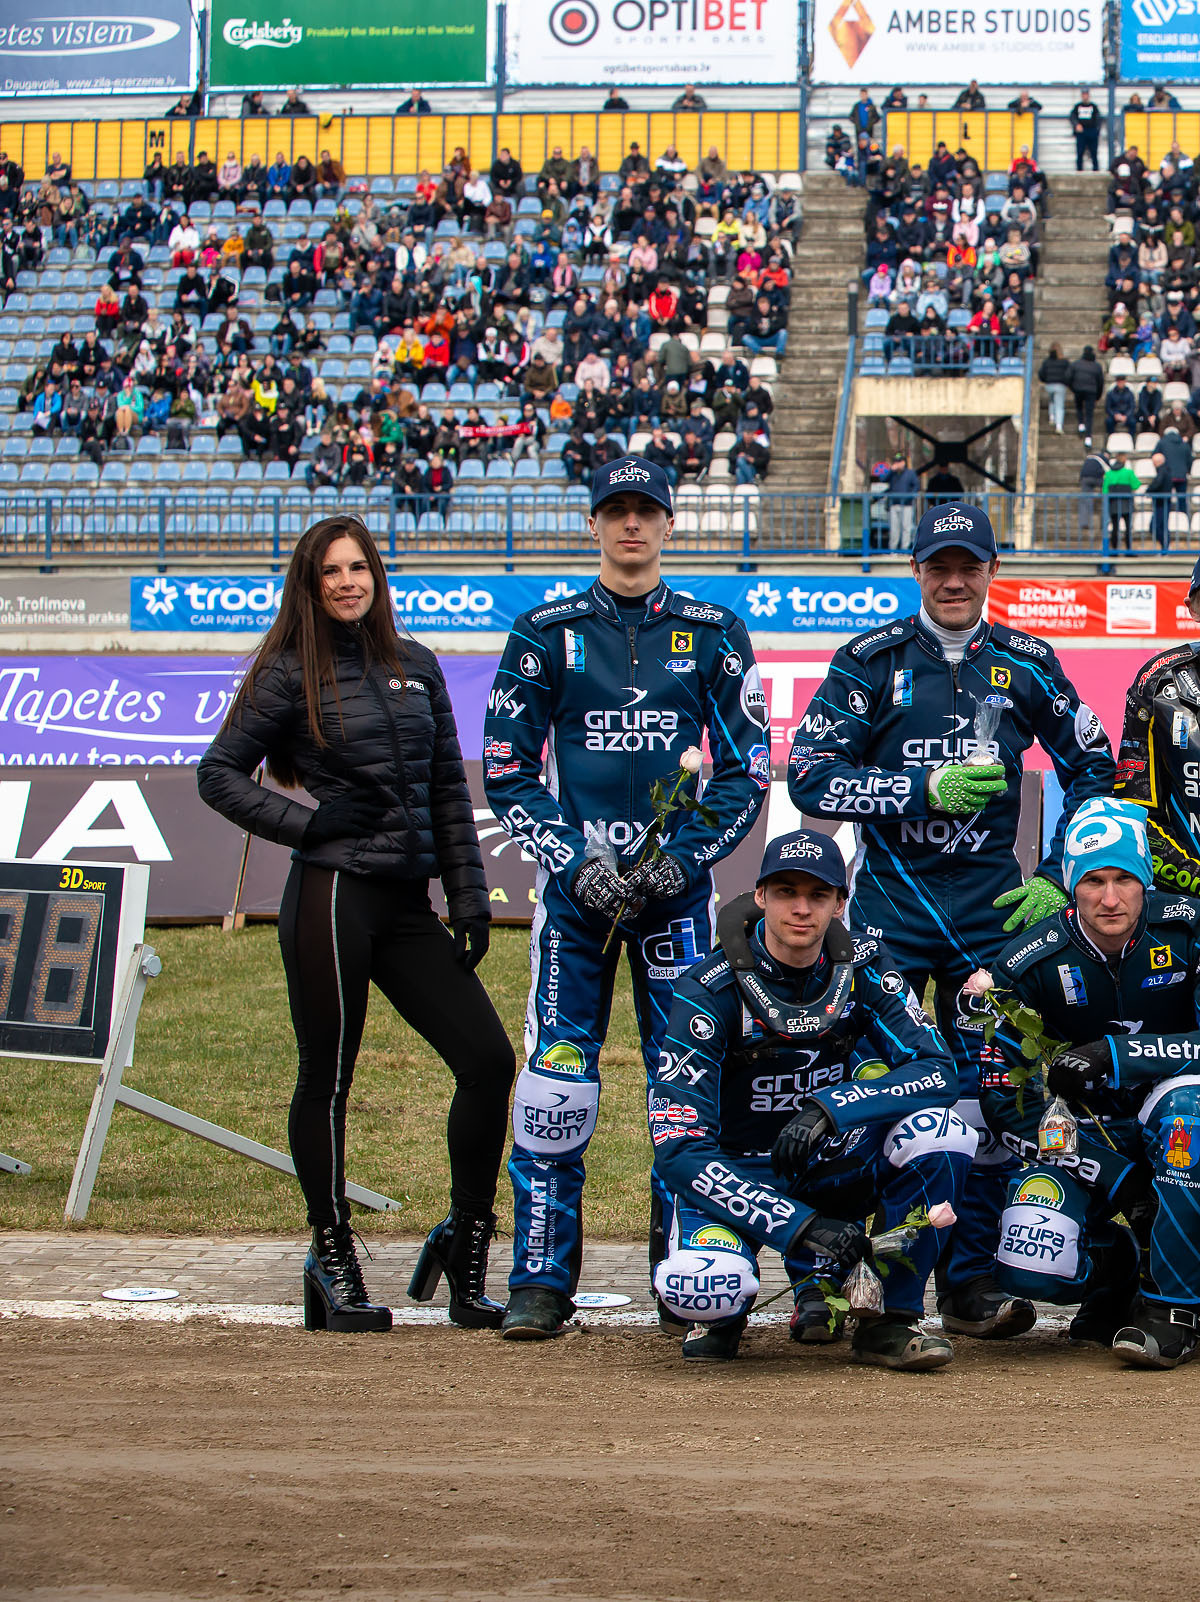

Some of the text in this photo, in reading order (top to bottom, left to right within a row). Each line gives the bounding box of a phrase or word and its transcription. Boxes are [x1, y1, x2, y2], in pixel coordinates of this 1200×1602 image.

[613, 0, 768, 31] OPTIBET
[887, 9, 1091, 33] AMBER STUDIOS
[222, 18, 303, 49] Carlsberg
[306, 27, 349, 38] Probably
[445, 24, 475, 35] World
[150, 130, 165, 147] M
[390, 585, 493, 613] trodo
[787, 587, 898, 614] trodo
[1110, 588, 1152, 601] PUFAS
[191, 615, 214, 626] CAR
[216, 615, 253, 627] PARTS
[414, 615, 492, 626] PARTS ONLINE
[531, 603, 573, 623] CHEMART
[793, 617, 853, 627] CAR PARTS
[1007, 604, 1087, 618] REMONTAM
[851, 631, 889, 655] CHEMART
[1180, 670, 1200, 697] CHEMART
[0, 668, 166, 734] Tapetes
[59, 867, 107, 891] 3D SPORT
[1006, 937, 1044, 969] CHEMART
[543, 927, 562, 1027] Saletromag
[649, 967, 675, 978] dasta
[1147, 975, 1165, 987] 2LŻ
[745, 974, 772, 1008] CHEMART
[1165, 1169, 1191, 1180] GMINA
[527, 1177, 548, 1274] CHEMART
[691, 1237, 742, 1252] ROZKWIT
